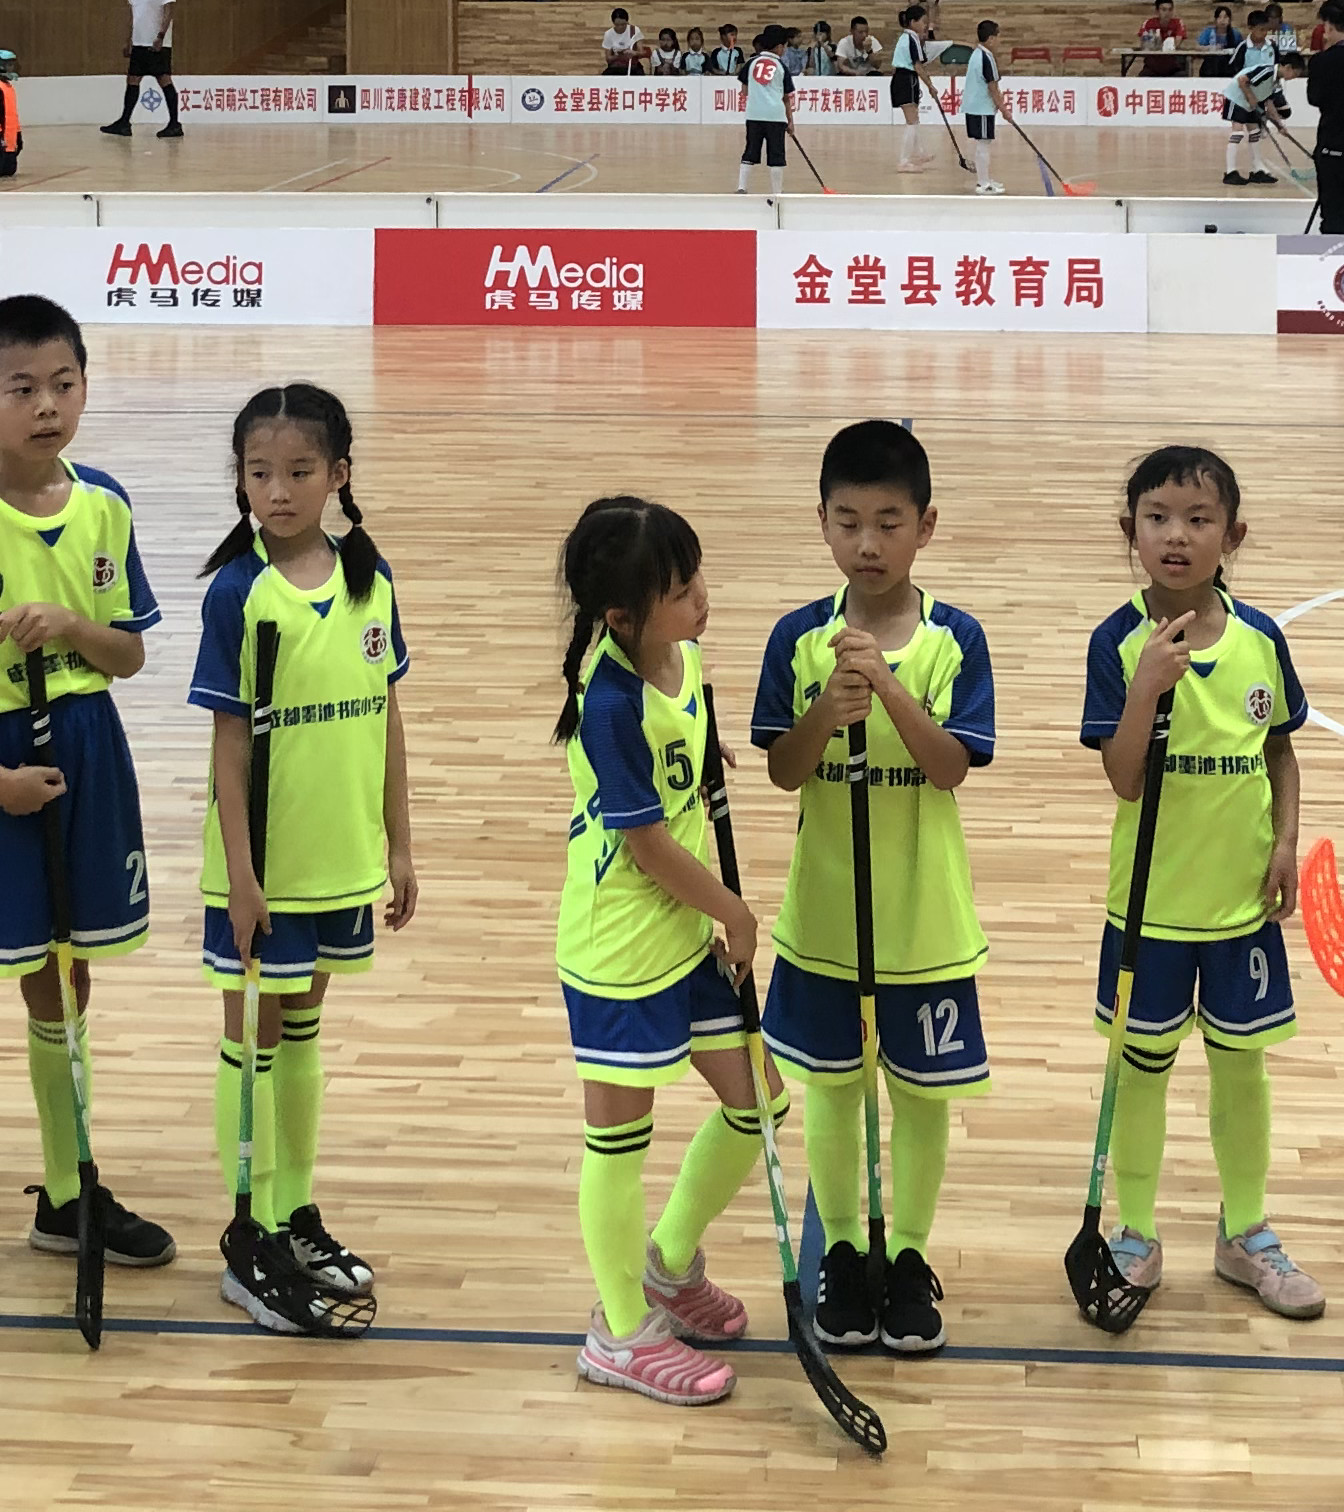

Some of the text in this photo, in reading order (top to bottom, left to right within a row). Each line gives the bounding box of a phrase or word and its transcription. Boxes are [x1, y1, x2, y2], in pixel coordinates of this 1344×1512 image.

[754, 61, 776, 81] 13
[553, 88, 688, 113] 金堂县淮口中学校
[105, 242, 264, 287] HMedia
[484, 244, 646, 289] HMedia
[792, 253, 1108, 308] 金堂县教育局
[105, 288, 264, 309] 虎马传媒
[484, 290, 646, 311] 虎马传媒
[125, 850, 148, 906] 2
[1248, 947, 1269, 1002] 9
[916, 997, 966, 1057] 12
